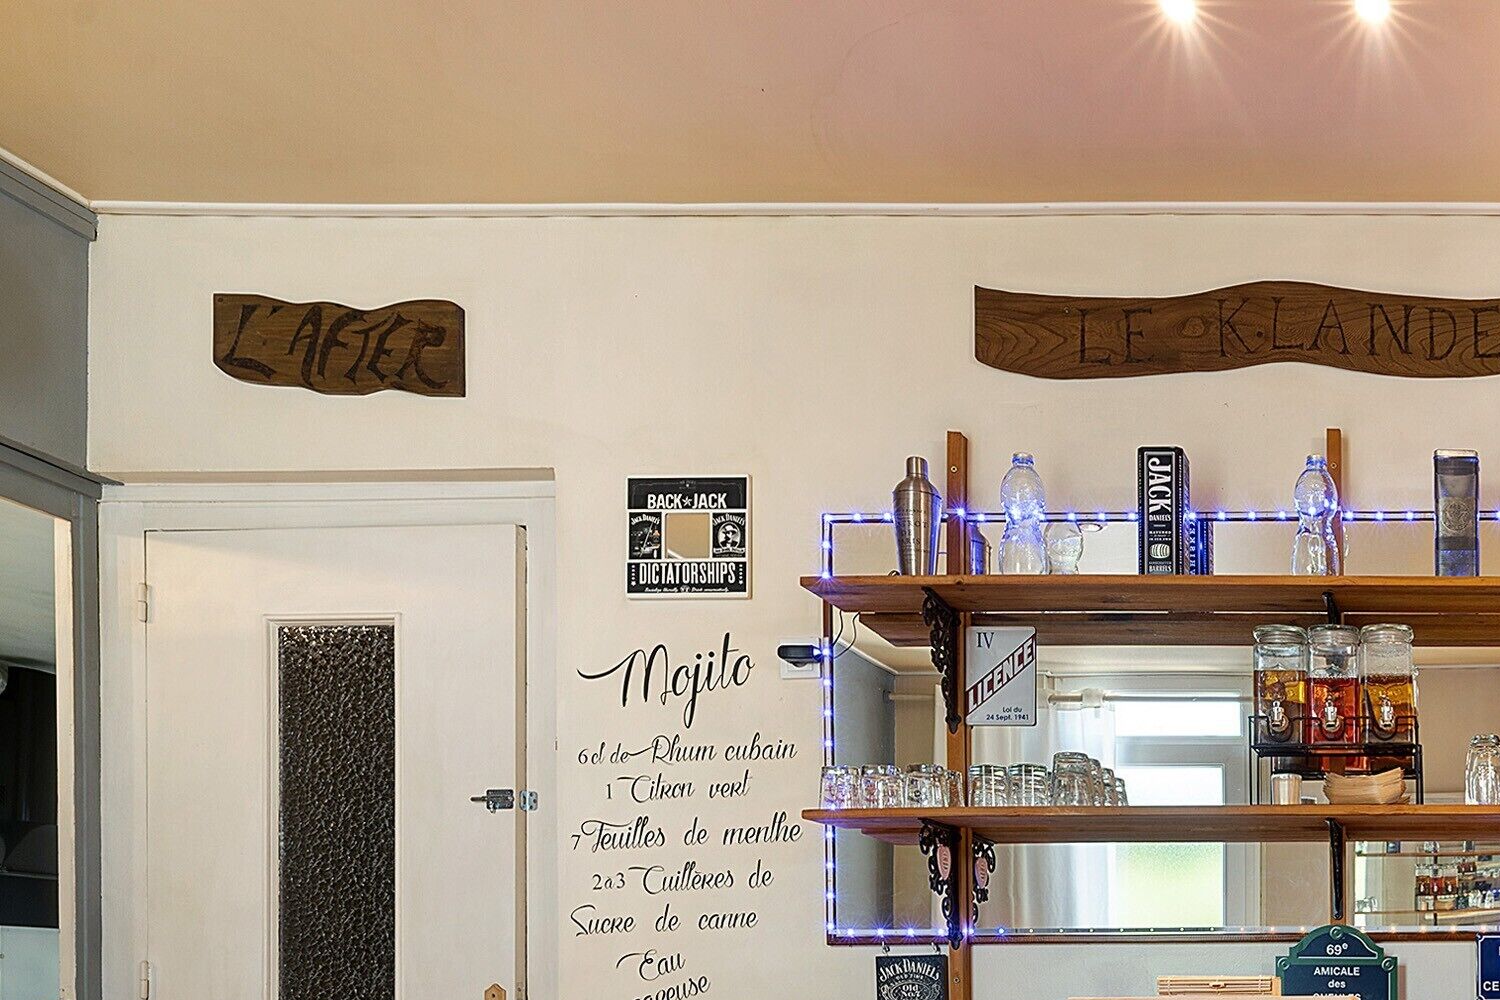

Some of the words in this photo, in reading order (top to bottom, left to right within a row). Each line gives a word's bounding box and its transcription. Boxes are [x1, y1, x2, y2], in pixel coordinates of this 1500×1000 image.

[1076, 308, 1158, 366] LE
[647, 493, 683, 509] BACK
[691, 492, 727, 509] JACK
[1148, 457, 1171, 513] JACK
[639, 562, 736, 585] DICTATORSHIPS
[976, 632, 995, 649] IV
[576, 632, 755, 728] Mojito
[968, 637, 1034, 713] LICENCE
[648, 734, 717, 765] Rhum
[724, 732, 798, 761] cubain
[606, 784, 612, 799] 1
[617, 773, 695, 803] Citron
[709, 770, 752, 798] vert
[571, 835, 581, 850] 7
[581, 816, 665, 853] Feuilles
[684, 817, 710, 845] de
[723, 811, 803, 845] menthe
[749, 859, 774, 889] de
[570, 904, 637, 937] Sucre
[655, 904, 681, 932] de
[698, 911, 759, 930] canne
[616, 949, 686, 981] Eau
[880, 962, 903, 982] JACK
[1313, 967, 1360, 976] AMICALE
[1328, 979, 1346, 988] des
